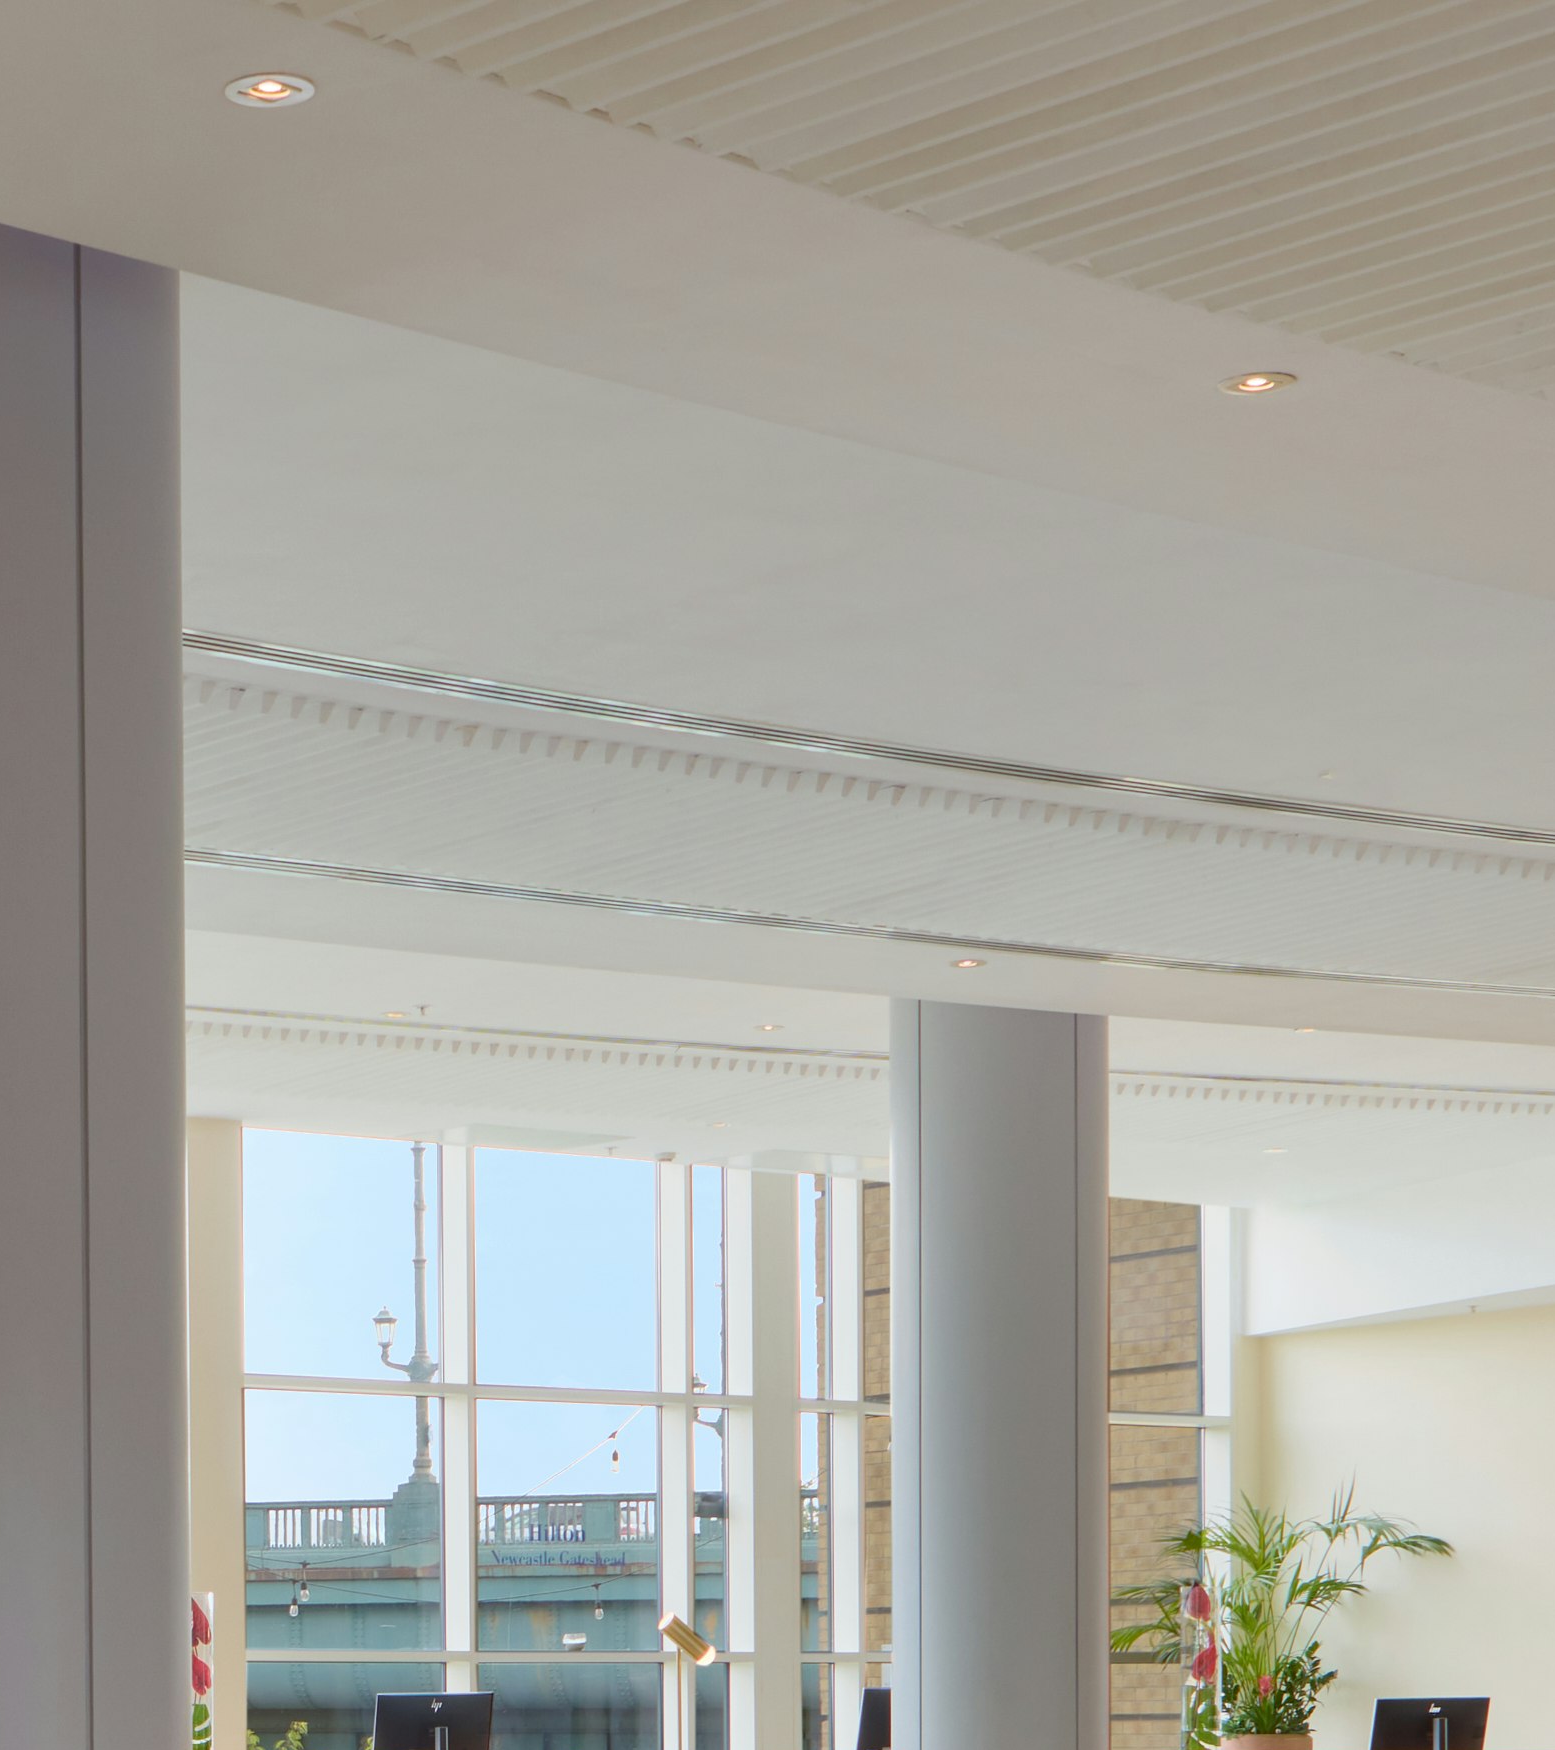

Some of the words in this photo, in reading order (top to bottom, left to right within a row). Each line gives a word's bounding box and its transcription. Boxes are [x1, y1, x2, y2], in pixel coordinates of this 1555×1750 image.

[529, 1524, 586, 1542] Hilton
[491, 1550, 555, 1565] Newcastle
[559, 1551, 626, 1566] Gateshead
